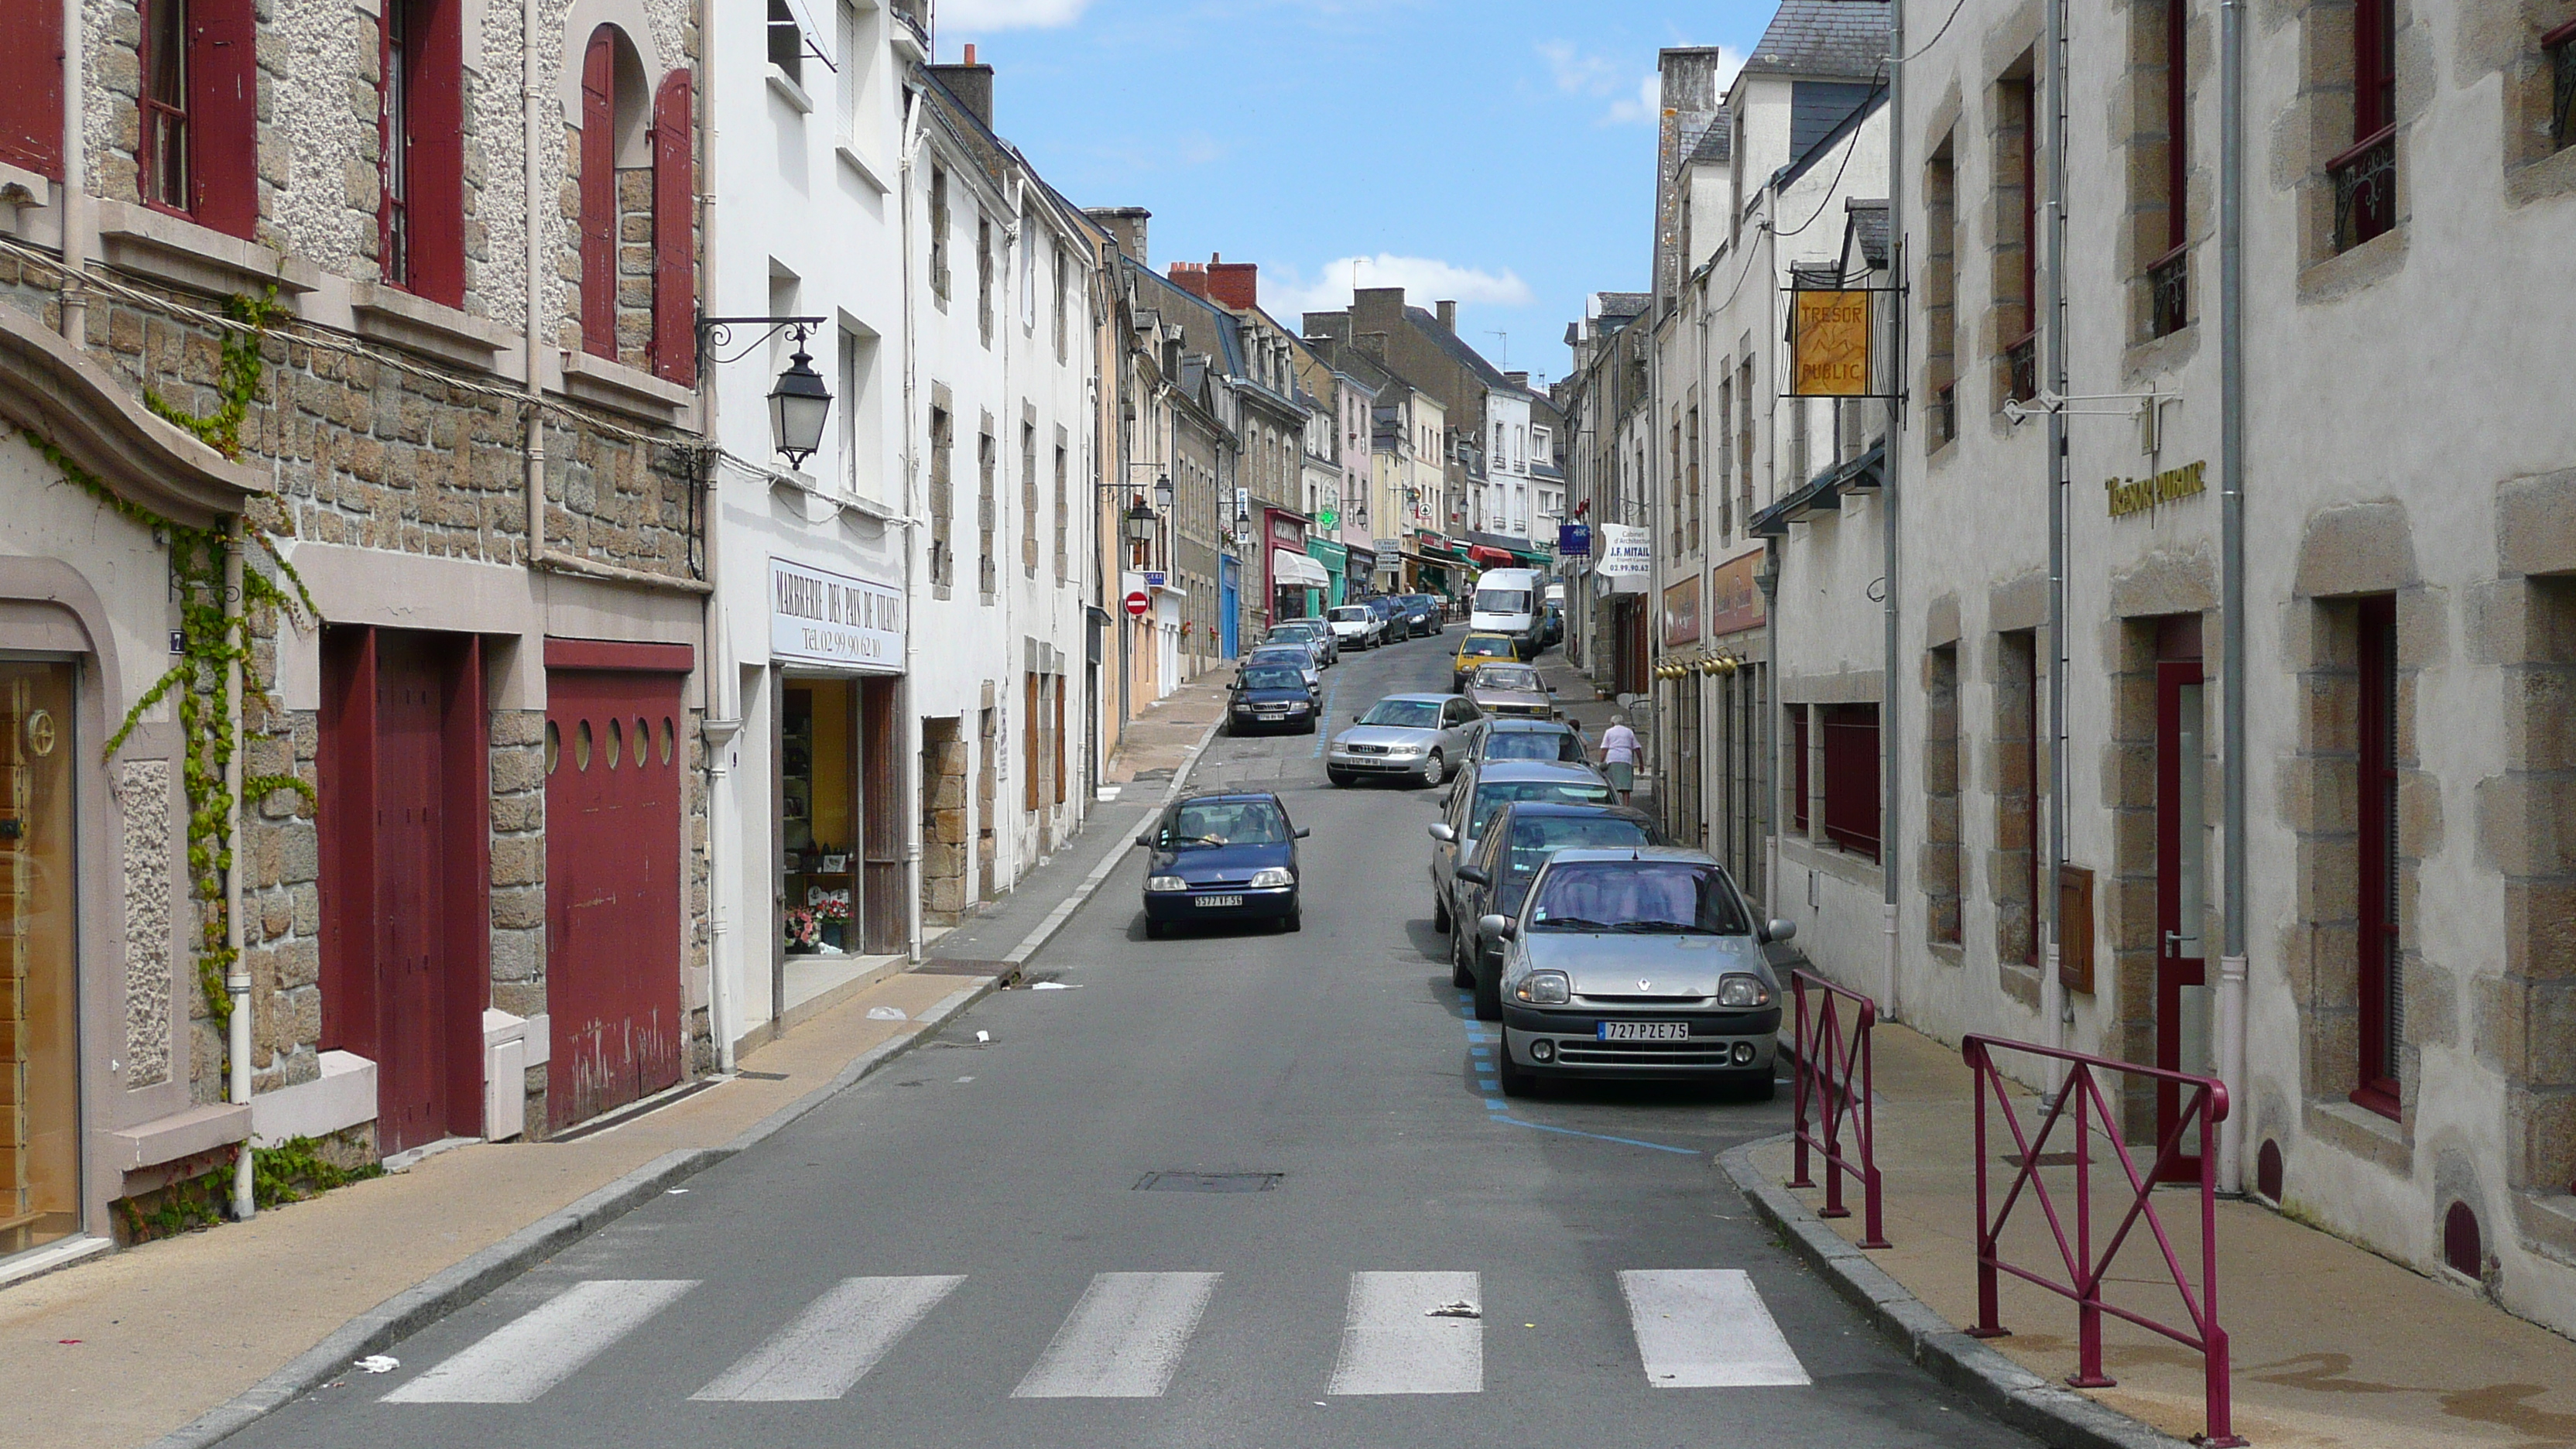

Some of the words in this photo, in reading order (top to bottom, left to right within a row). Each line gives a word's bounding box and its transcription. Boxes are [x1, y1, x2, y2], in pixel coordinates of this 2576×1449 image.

[1802, 307, 1862, 324] TRESOR
[1803, 363, 1860, 380] PUBLIC
[1610, 546, 1622, 557] J.F.
[1624, 546, 1650, 557] MITAIL
[1609, 564, 1649, 572] 02.99.90.62
[776, 570, 823, 622] MARBRERIE
[827, 582, 841, 625] DES
[864, 591, 873, 629] DE
[174, 633, 181, 650] 7
[802, 627, 820, 651] Tél.
[820, 630, 833, 652] 02
[834, 632, 846, 655] 99
[848, 634, 858, 657] 90
[861, 636, 871, 656] 62
[872, 639, 881, 658] 10
[1196, 896, 1217, 906] 5577
[1610, 1023, 1635, 1039] 727
[1639, 1024, 1665, 1039] PZE
[1670, 1024, 1687, 1039] 75
